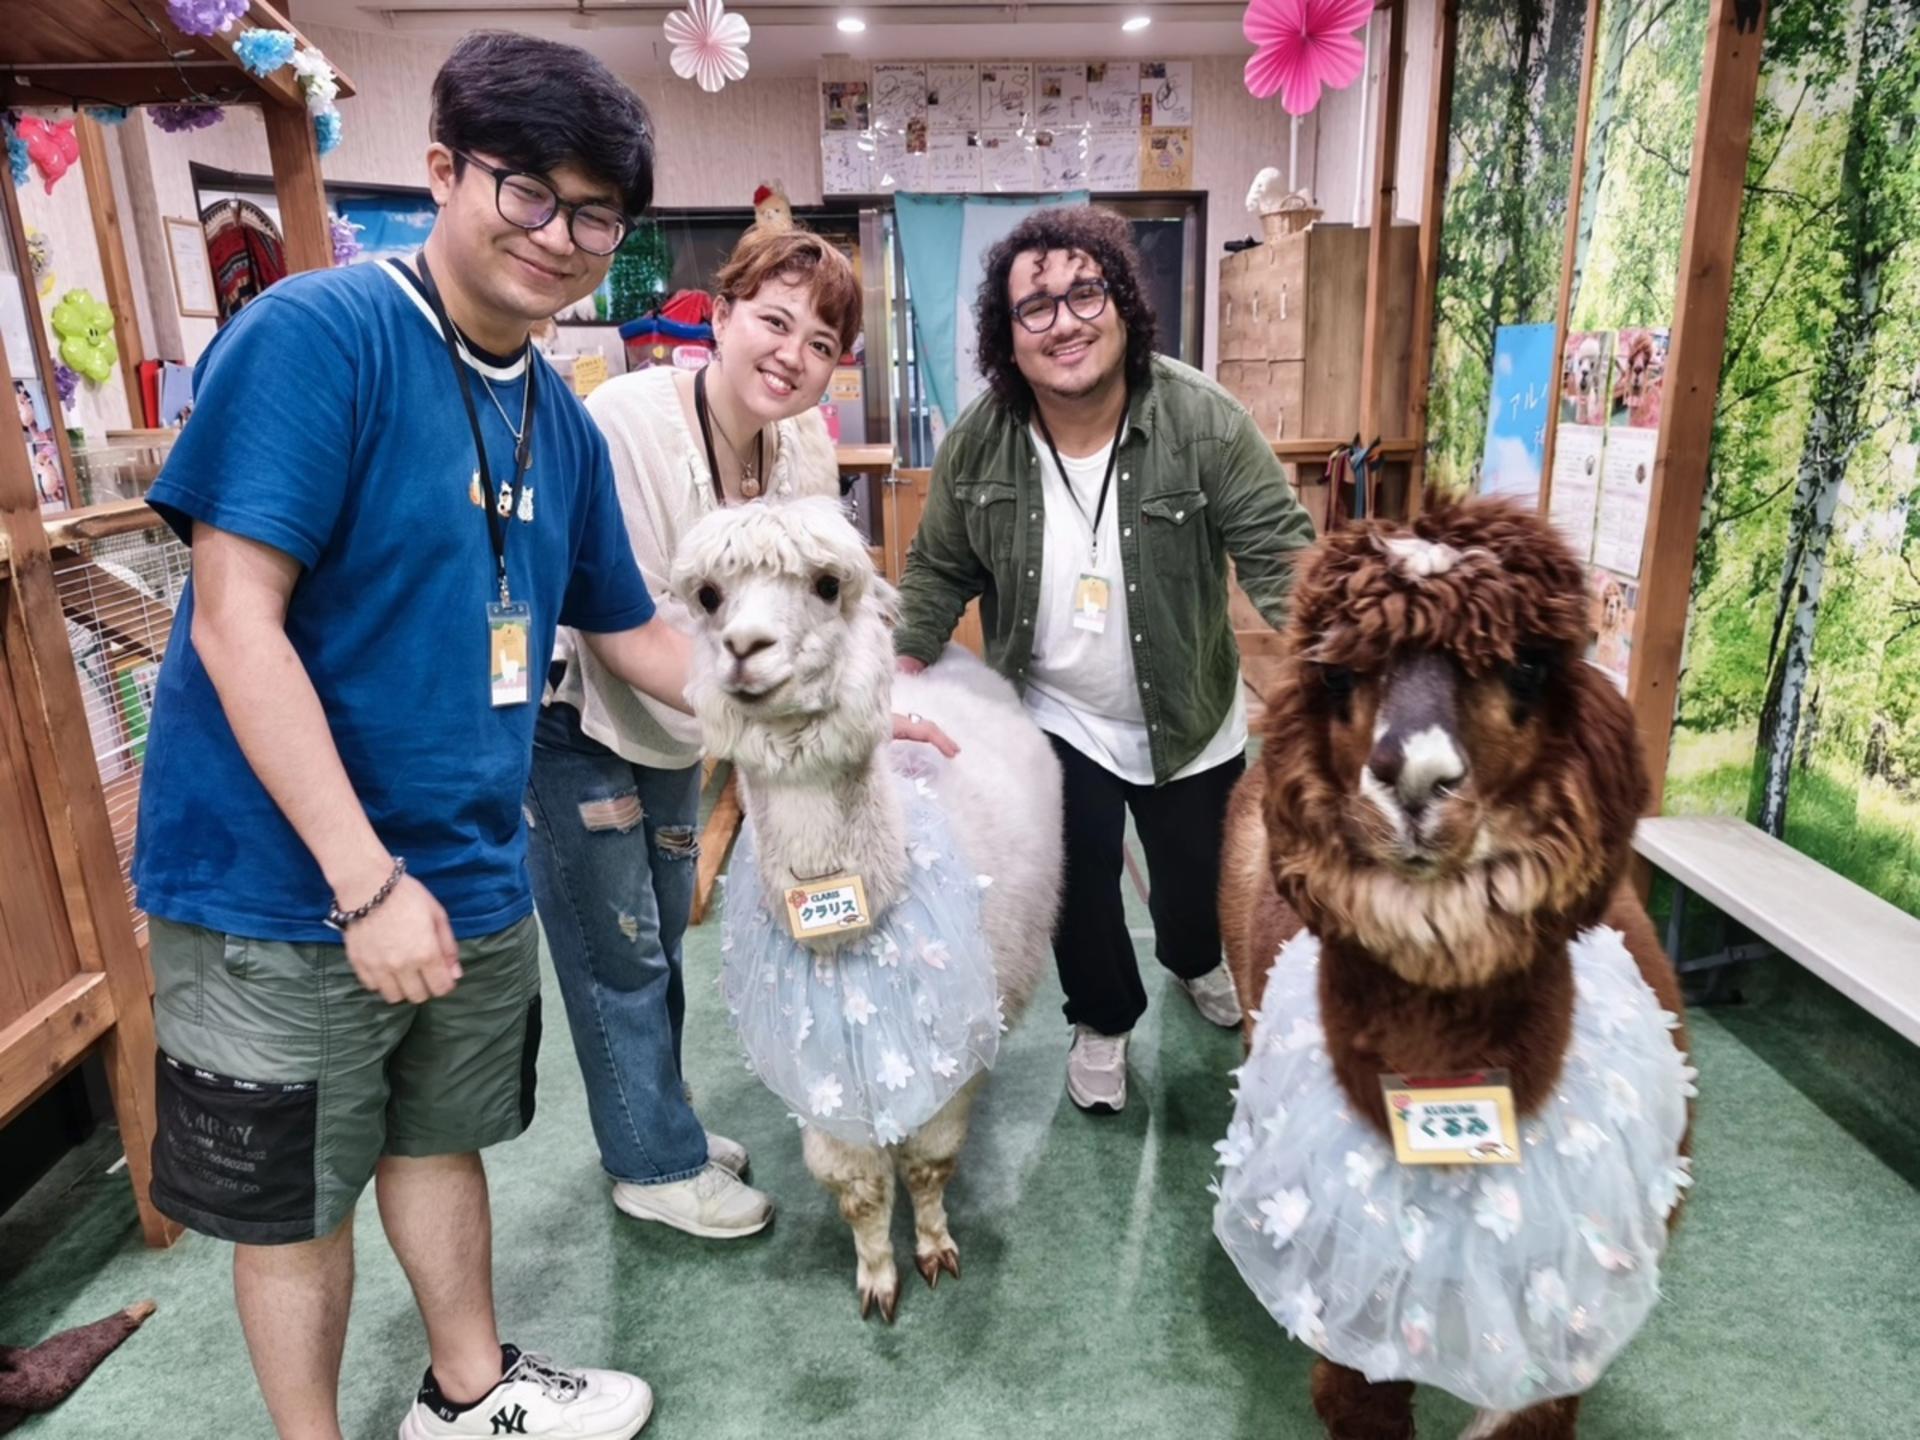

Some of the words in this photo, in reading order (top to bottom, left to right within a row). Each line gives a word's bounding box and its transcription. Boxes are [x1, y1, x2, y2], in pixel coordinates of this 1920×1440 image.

[810, 890, 840, 903] CLARIS
[801, 899, 856, 922] クラリス
[490, 1403, 528, 1435] NY
